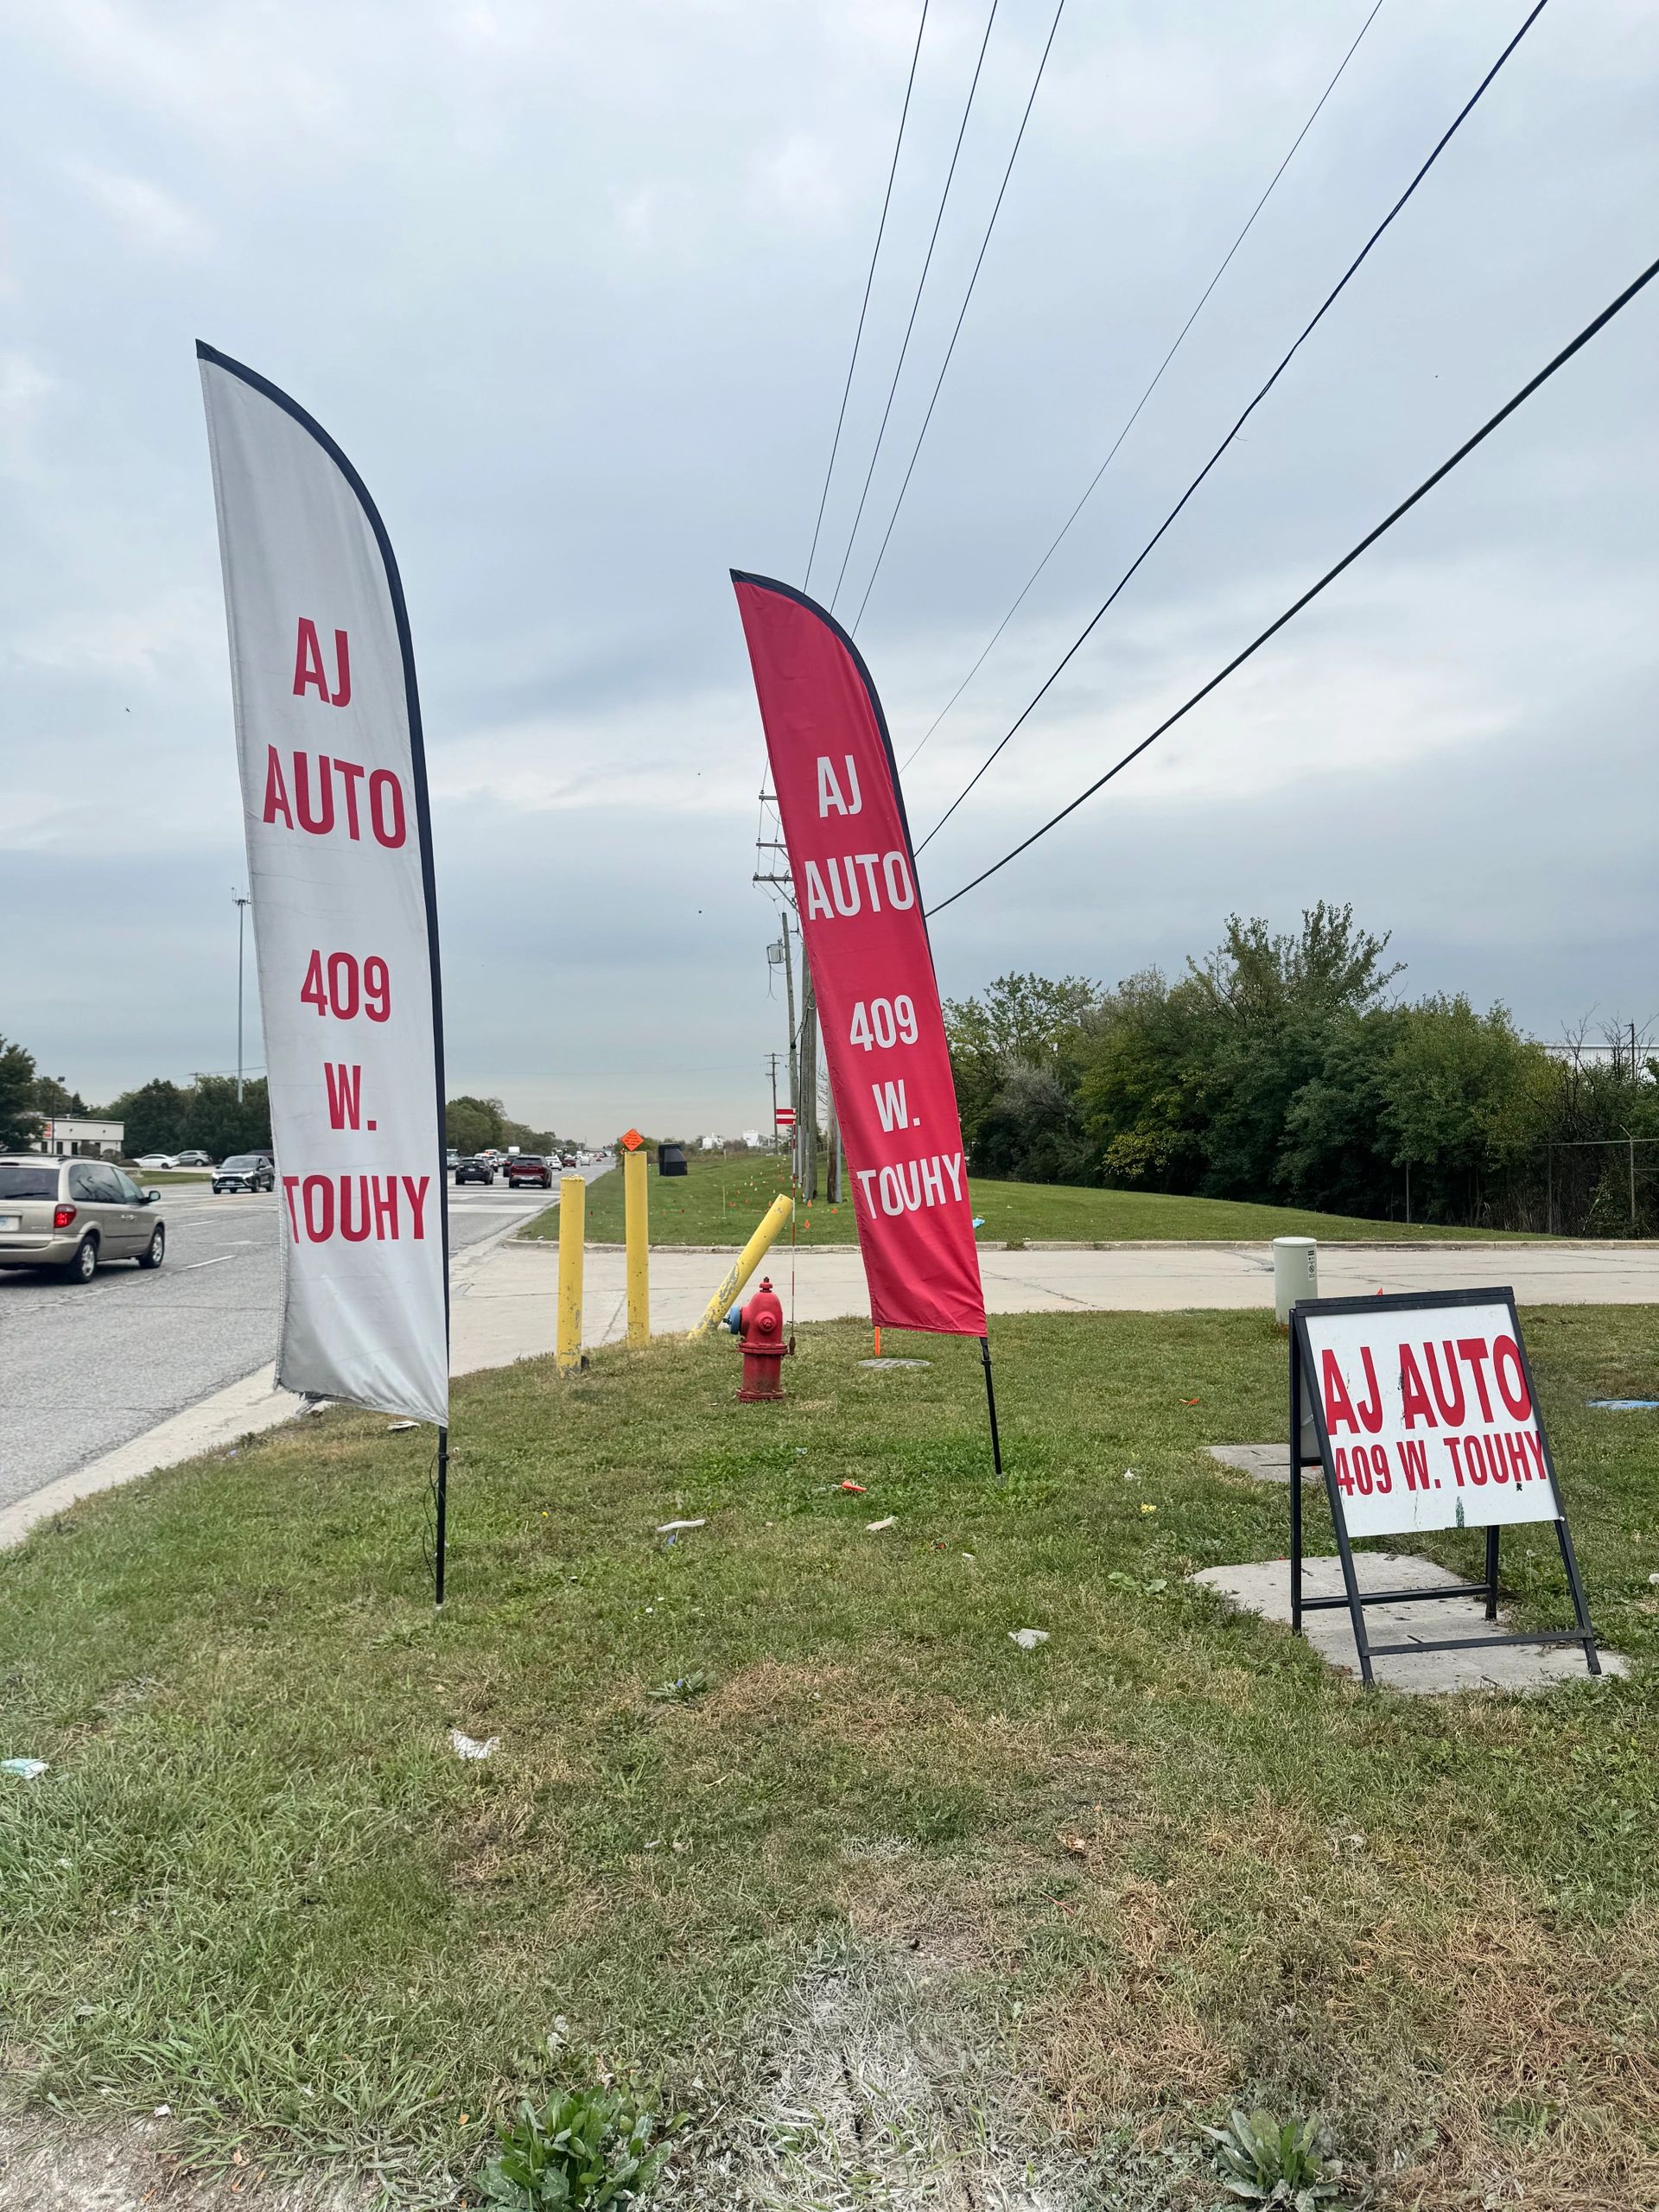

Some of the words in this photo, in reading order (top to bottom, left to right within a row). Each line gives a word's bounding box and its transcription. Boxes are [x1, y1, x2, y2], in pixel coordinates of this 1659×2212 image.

[293, 616, 351, 708] AJ
[264, 744, 407, 849] AUTO
[817, 754, 863, 818] AJ
[804, 850, 916, 921] AUTO
[300, 950, 391, 1022] 409
[849, 995, 918, 1052] 409
[324, 1063, 378, 1130] W.
[871, 1078, 921, 1133] W.
[283, 1174, 430, 1244] TOUHY
[855, 1152, 963, 1219] TOUHY
[1321, 1345, 1384, 1436] AJ
[1397, 1334, 1533, 1430] AUTO
[1334, 1443, 1393, 1497] 409
[1396, 1439, 1441, 1491] W.
[1443, 1430, 1548, 1487] TOUHY
